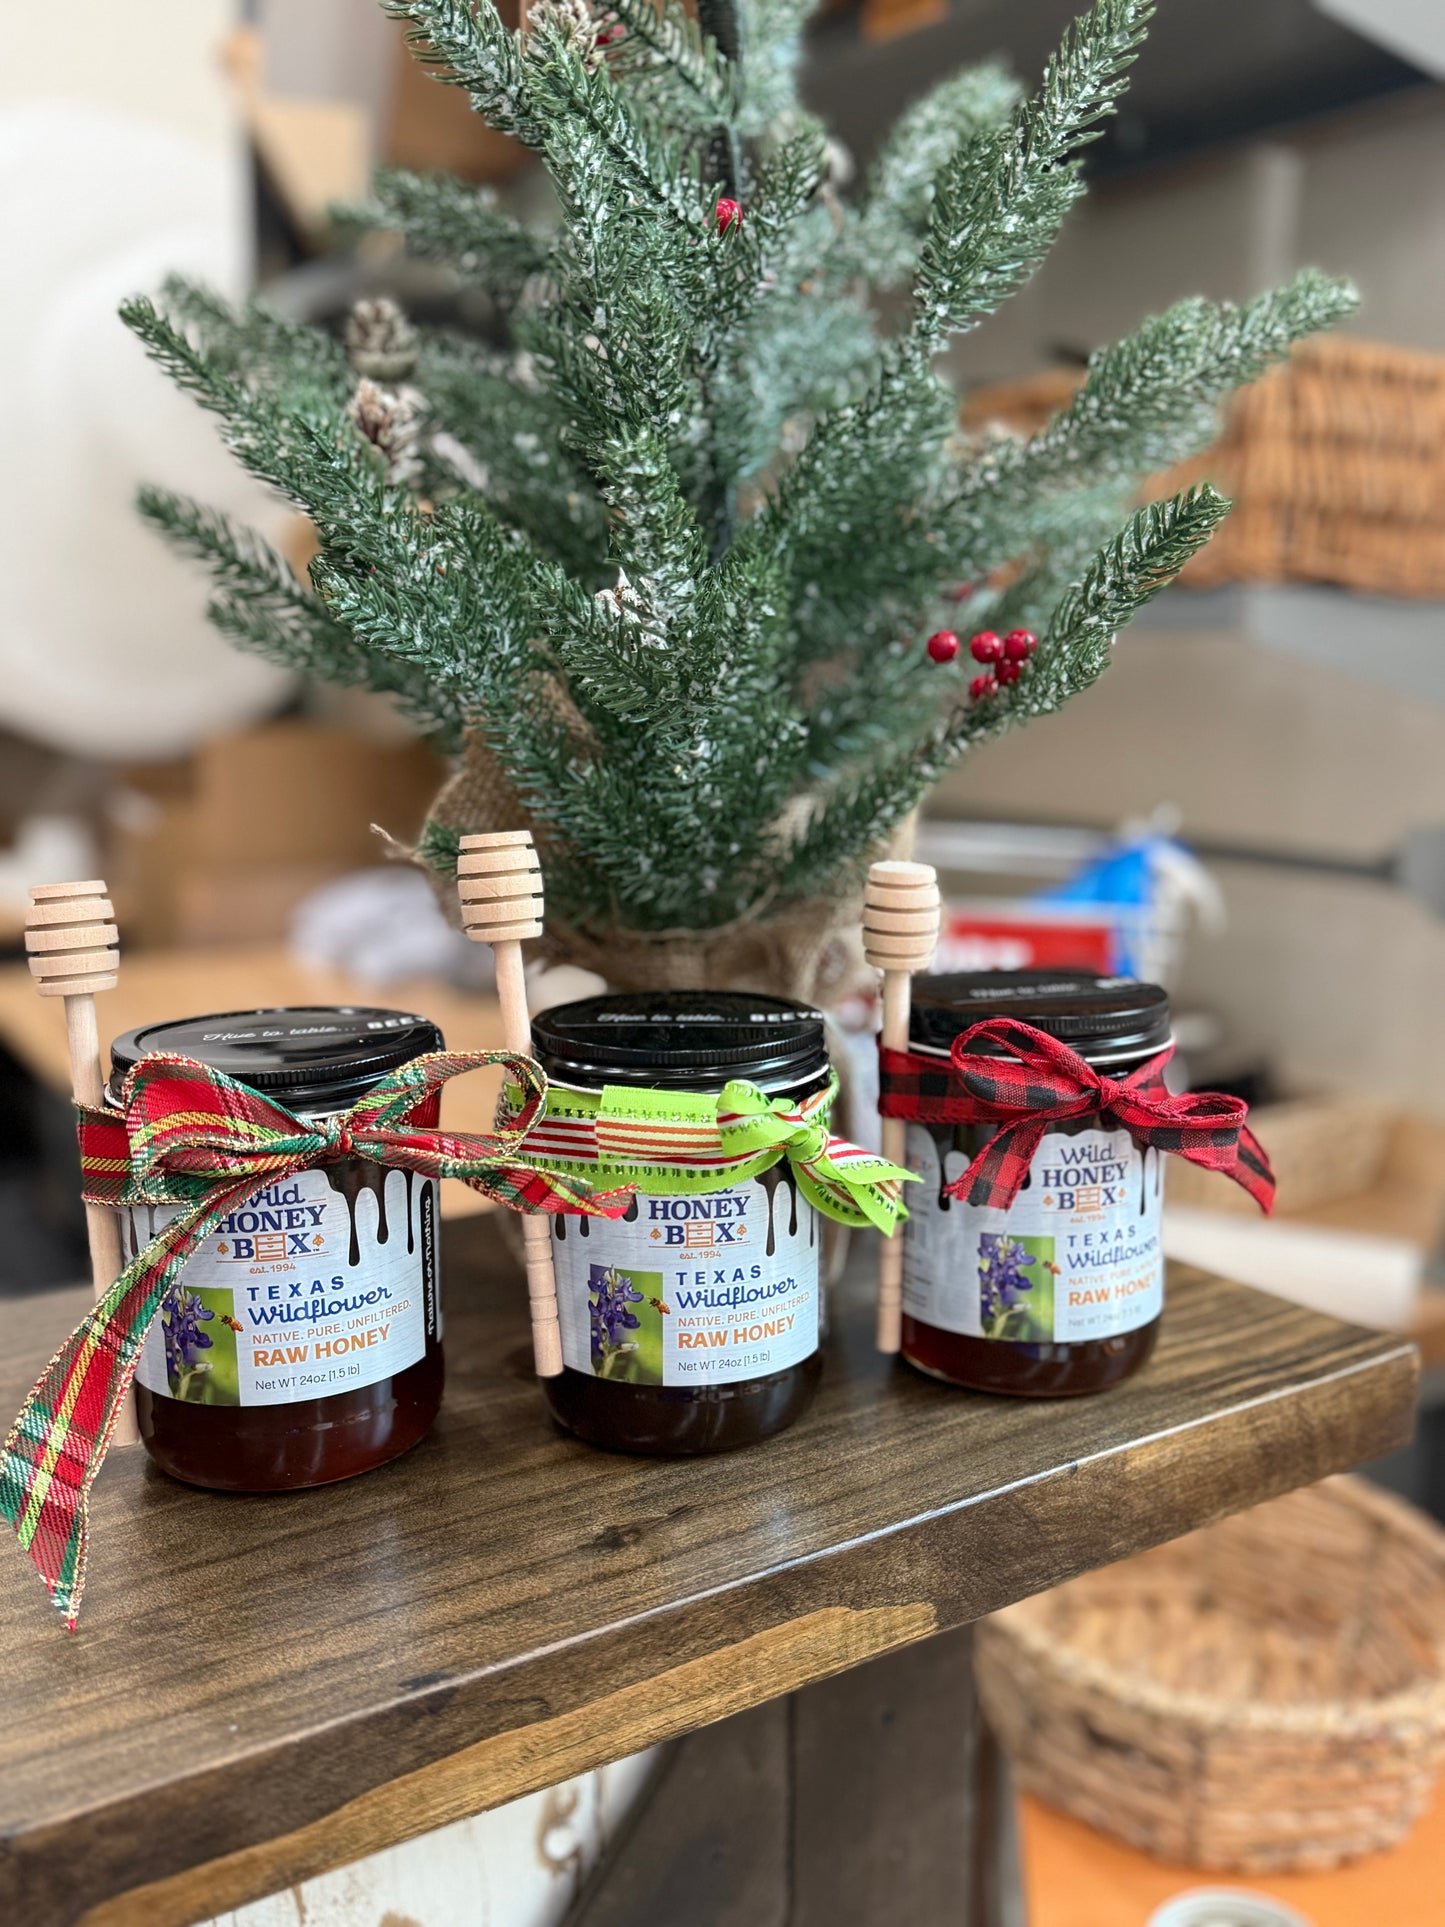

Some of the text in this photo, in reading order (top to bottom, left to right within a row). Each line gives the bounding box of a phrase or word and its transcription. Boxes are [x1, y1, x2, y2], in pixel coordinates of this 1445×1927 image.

[262, 1029, 284, 1038] to
[1060, 1142, 1116, 1166] Wild
[1041, 1161, 1128, 1188] HONEY
[215, 1204, 327, 1234] HONEY
[648, 1195, 751, 1221] HONEY
[1067, 1224, 1136, 1248] TEXAS
[698, 1250, 722, 1260] 1994
[270, 1262, 297, 1274] 1994
[676, 1265, 761, 1286] TEXAS
[247, 1275, 344, 1301] TEXAS
[676, 1277, 798, 1309] Wildflower
[1068, 1287, 1111, 1306] RAW
[248, 1286, 393, 1326] Wildflower
[252, 1299, 412, 1345] NATIVE. PURE. UNFILTERED.
[678, 1316, 724, 1328] NATIVE.
[727, 1310, 760, 1324] PURE.
[678, 1313, 796, 1349] RAW HONEY
[254, 1323, 391, 1368] RAW HONEY
[678, 1362, 697, 1372] Net
[699, 1360, 717, 1371] WT
[718, 1358, 742, 1370] 24oz
[255, 1380, 276, 1391] Net
[278, 1376, 297, 1388] WT
[299, 1373, 327, 1386] 24oz
